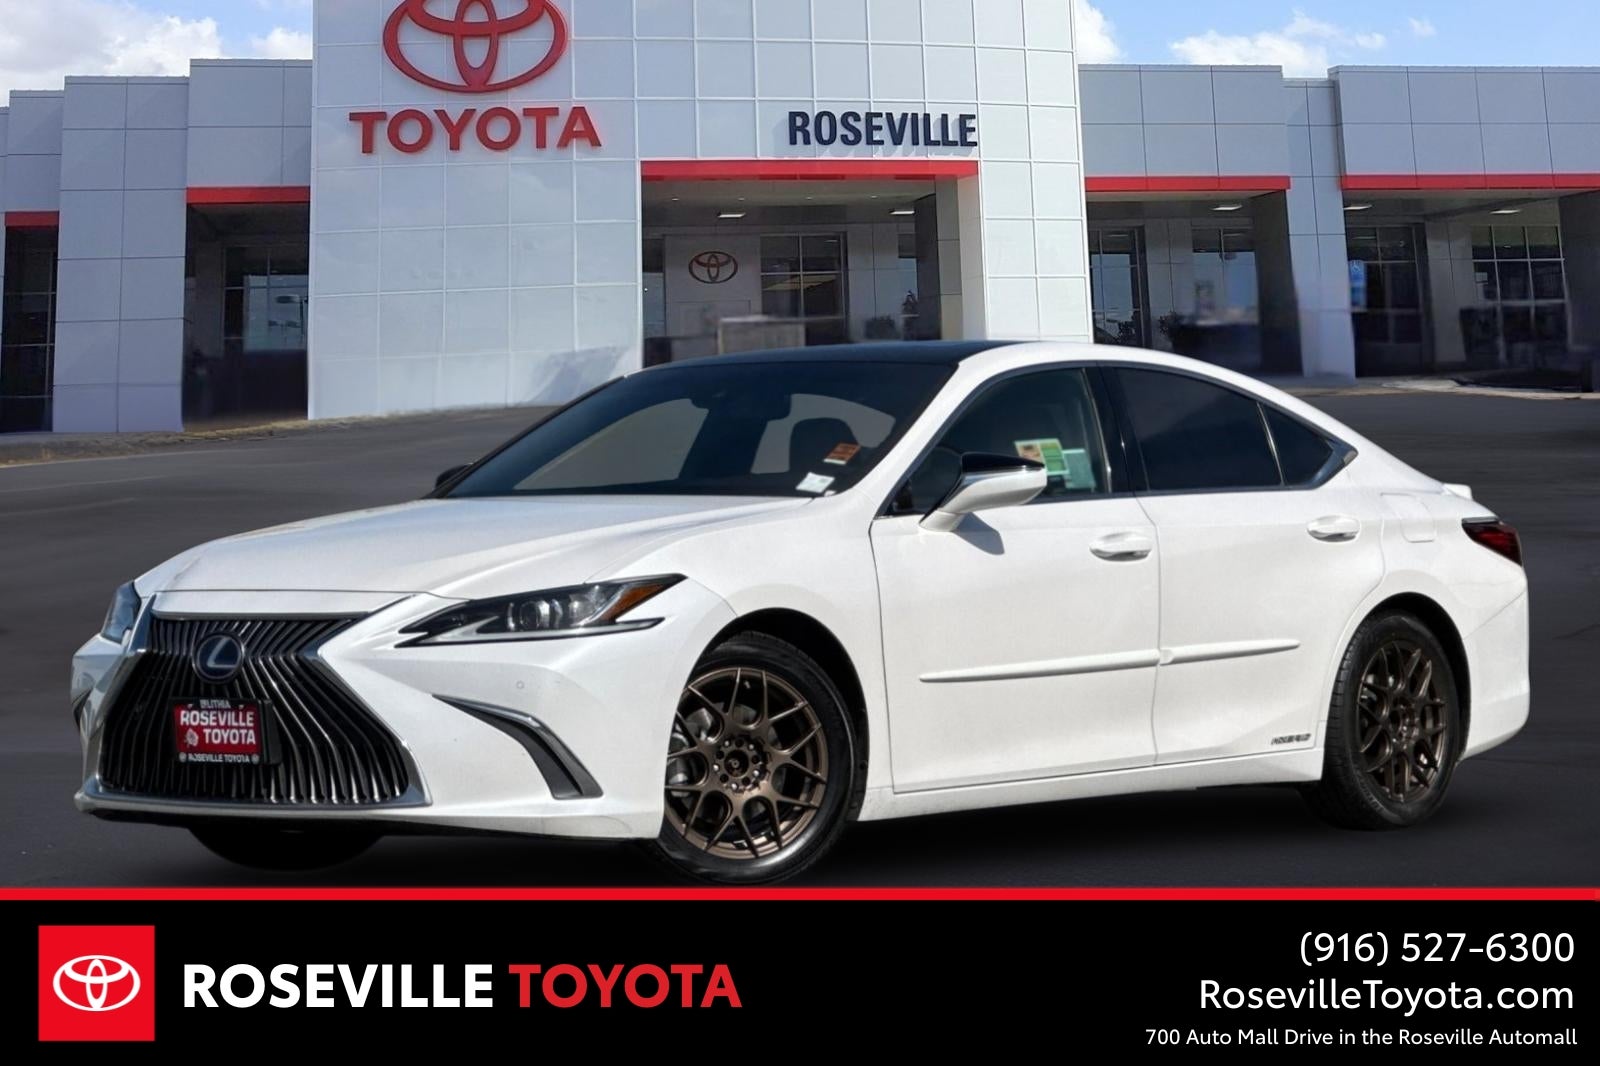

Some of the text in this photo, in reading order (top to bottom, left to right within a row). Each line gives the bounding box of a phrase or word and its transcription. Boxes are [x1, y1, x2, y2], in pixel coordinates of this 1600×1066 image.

[349, 106, 602, 154] TOYOTA
[788, 110, 978, 147] ROSEVILLE
[180, 711, 255, 727] ROSEVILLE
[203, 728, 256, 745] TOYOTA
[188, 753, 250, 763] ROSEVILLE TOYOTA
